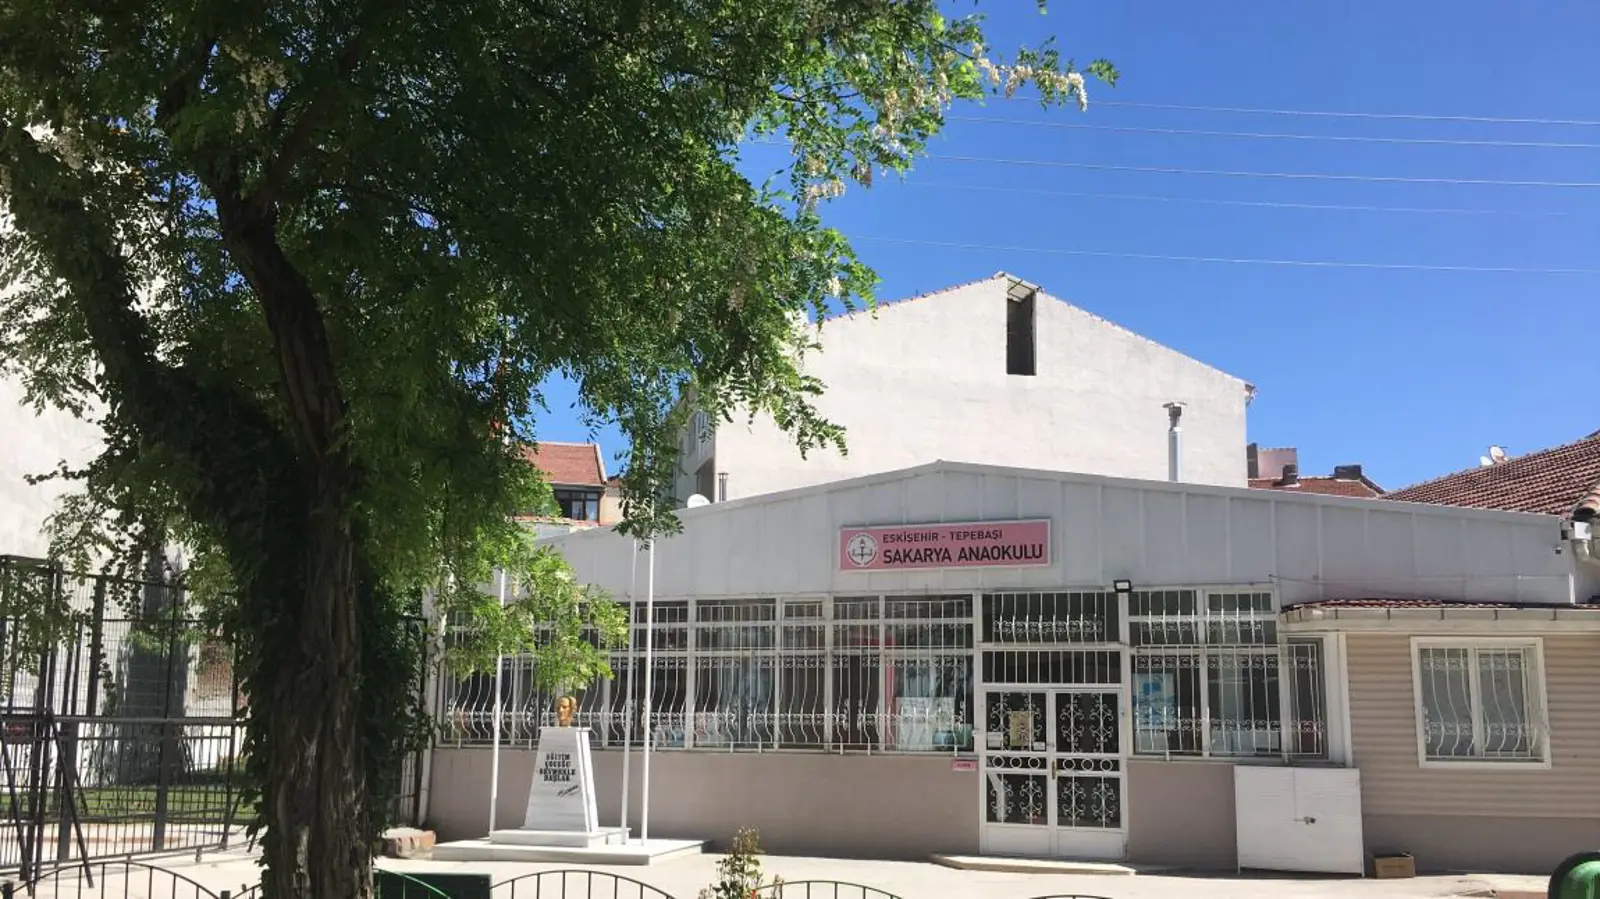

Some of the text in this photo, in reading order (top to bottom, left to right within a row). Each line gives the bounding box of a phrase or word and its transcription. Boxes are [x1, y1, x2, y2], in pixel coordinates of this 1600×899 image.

[883, 531, 939, 544] ESKİŞEHİR
[949, 529, 1003, 541] TEPEBAŞI
[883, 547, 952, 565] SAKARYA
[957, 543, 1043, 562] ANAOKULU
